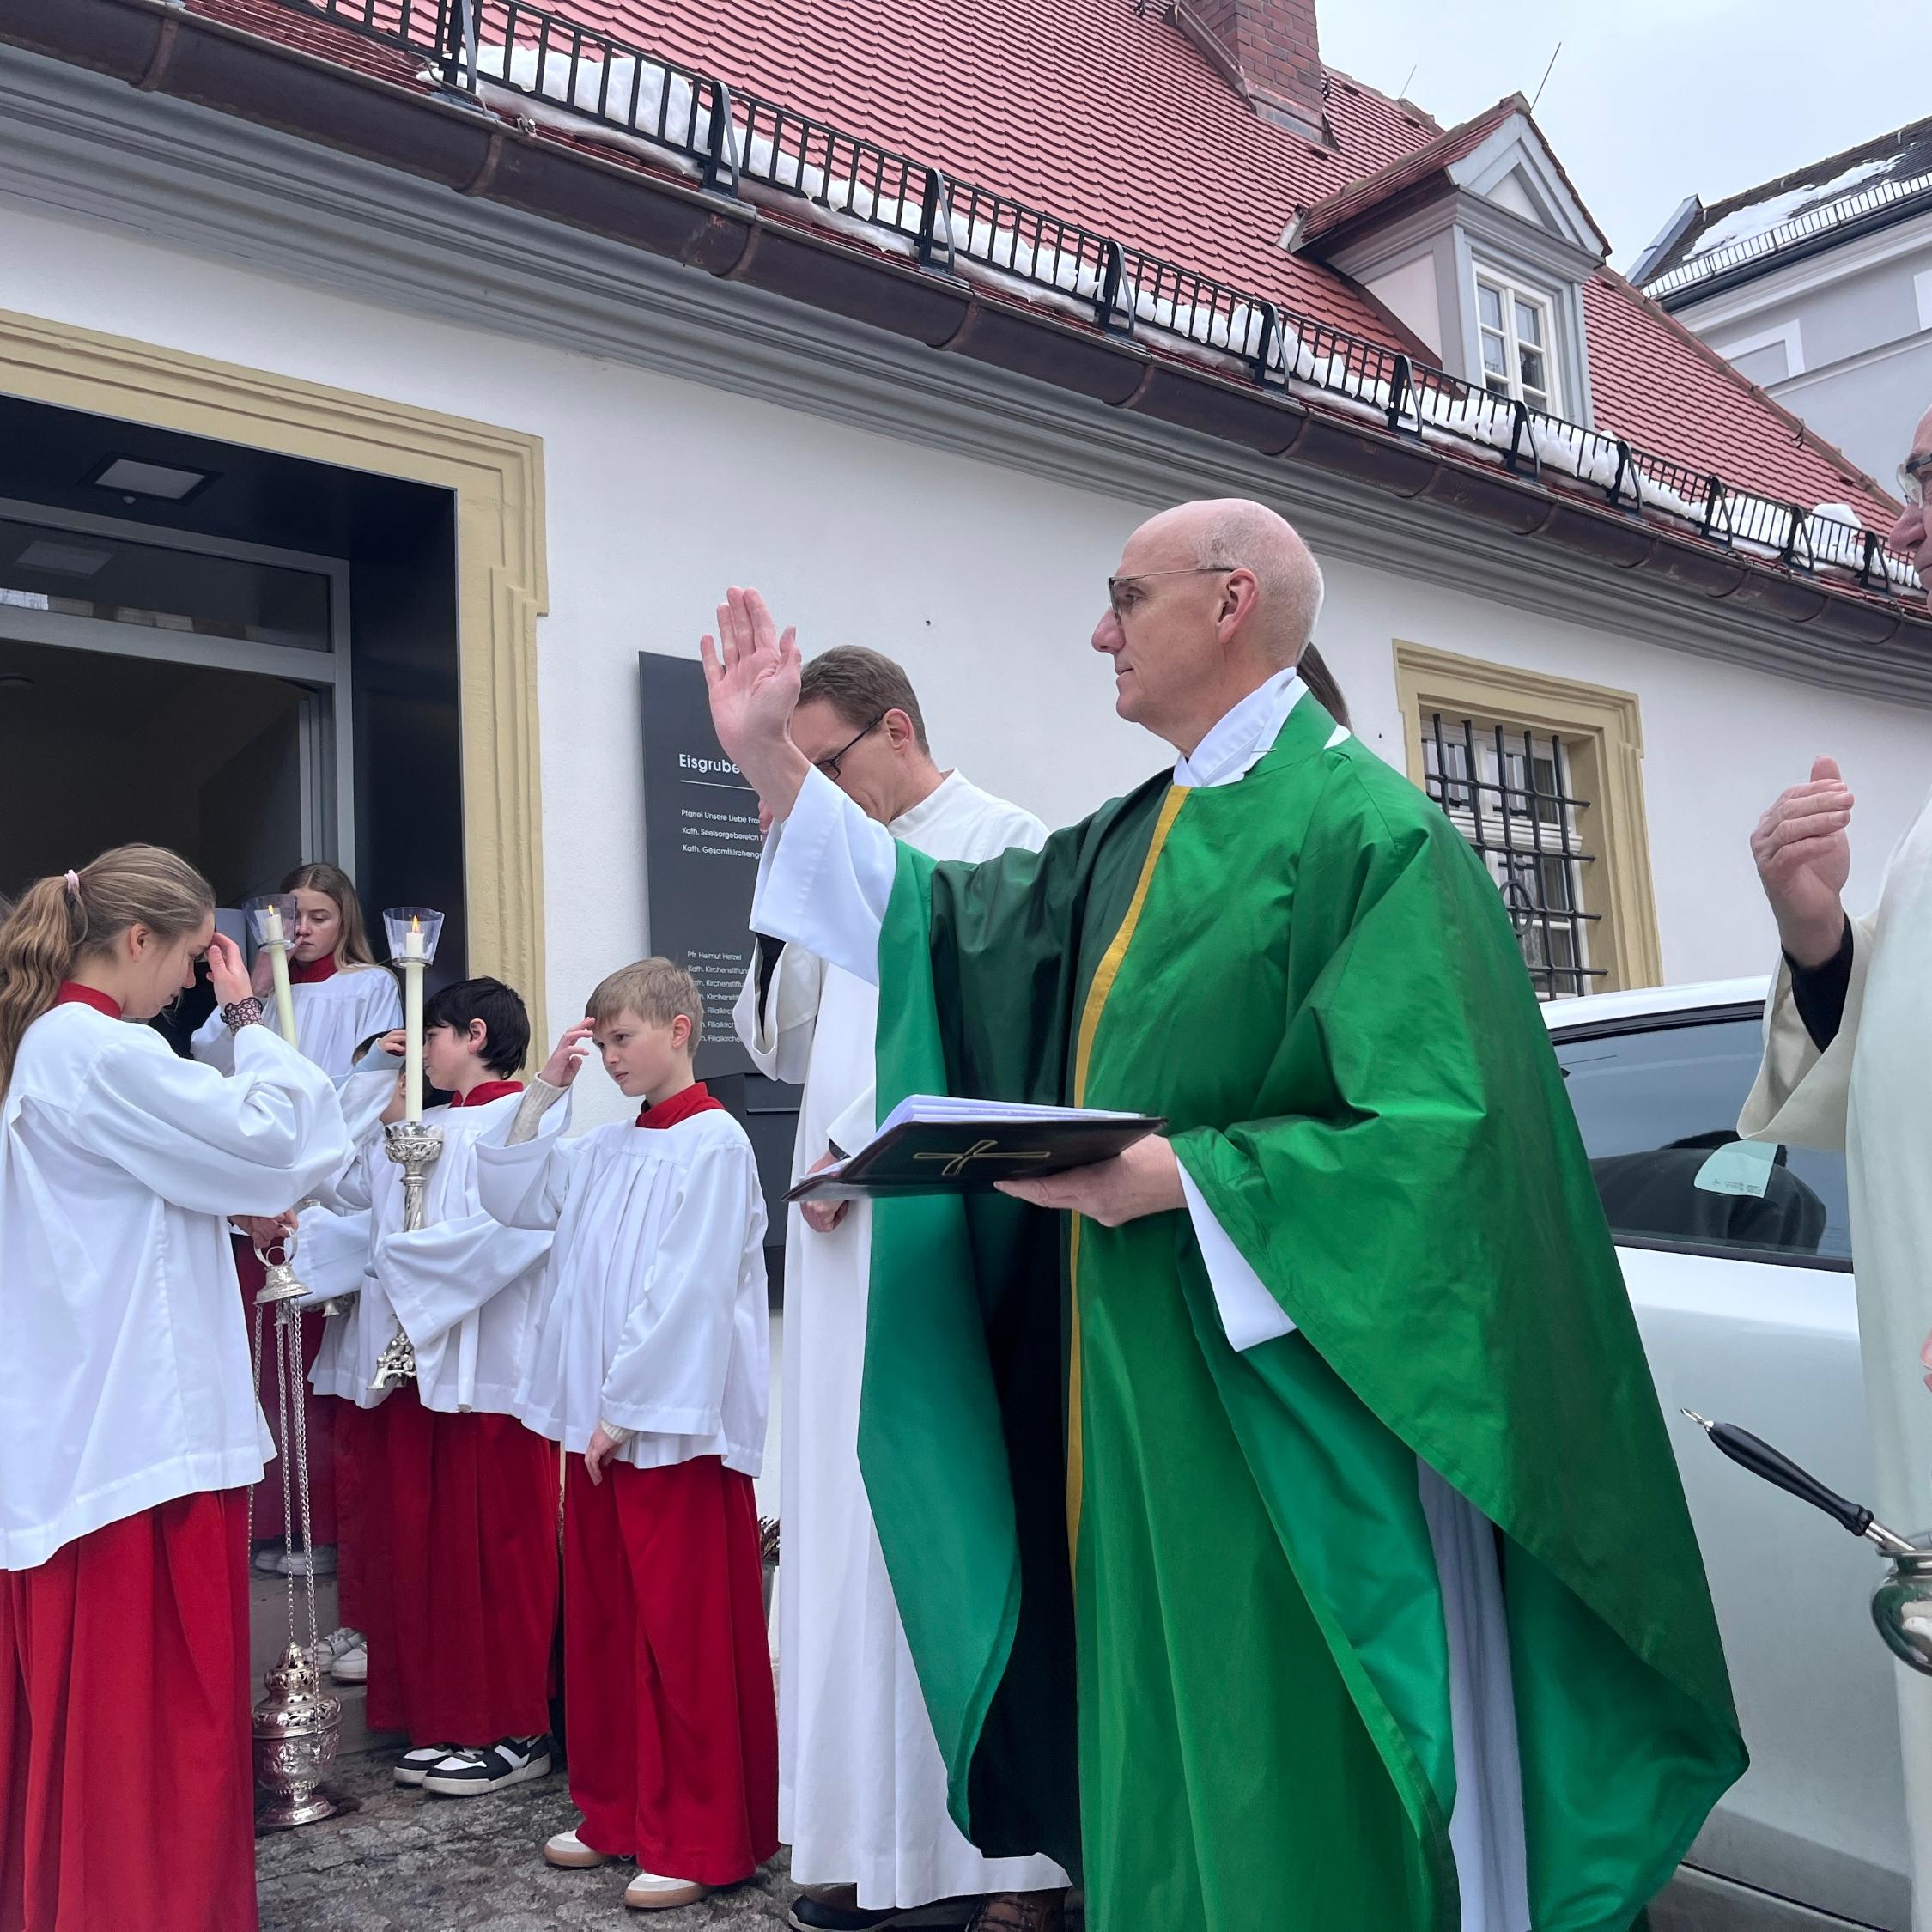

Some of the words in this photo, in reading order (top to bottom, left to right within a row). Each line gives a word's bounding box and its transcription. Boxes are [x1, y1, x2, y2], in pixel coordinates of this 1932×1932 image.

[679, 753, 740, 774] Eisgrube
[681, 809, 703, 818] Pfarrei
[704, 811, 727, 821] Unsere
[729, 814, 747, 823] Liebe
[682, 827, 700, 835] Kath.
[701, 829, 759, 841] Seelsorgebereich
[683, 844, 701, 853] Kath.
